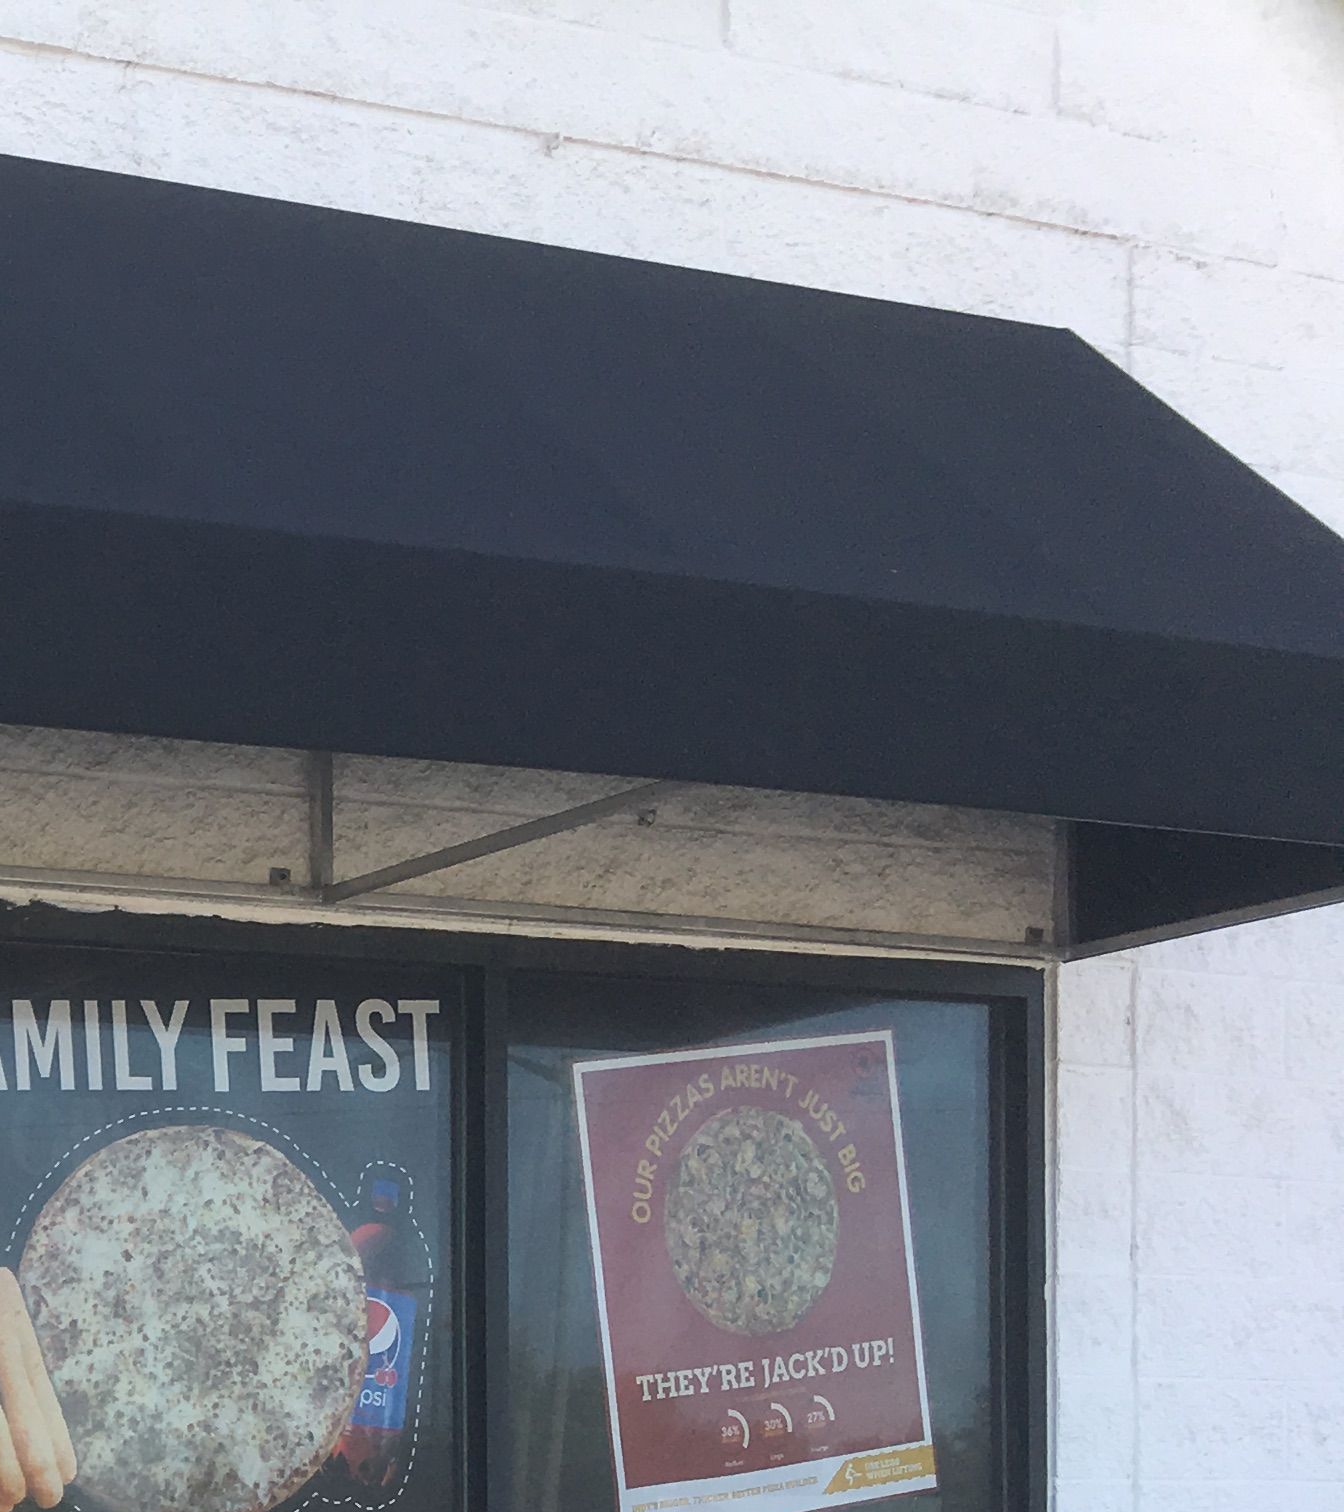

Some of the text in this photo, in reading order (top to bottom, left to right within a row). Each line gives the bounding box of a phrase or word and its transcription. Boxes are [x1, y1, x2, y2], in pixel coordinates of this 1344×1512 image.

[210, 998, 440, 1092] FEAST
[631, 1064, 866, 1223] OUR PIZZAS AREN'T JUST BIG
[360, 1388, 387, 1408] psi
[636, 1338, 896, 1402] THEY'RE JACK'D UP!
